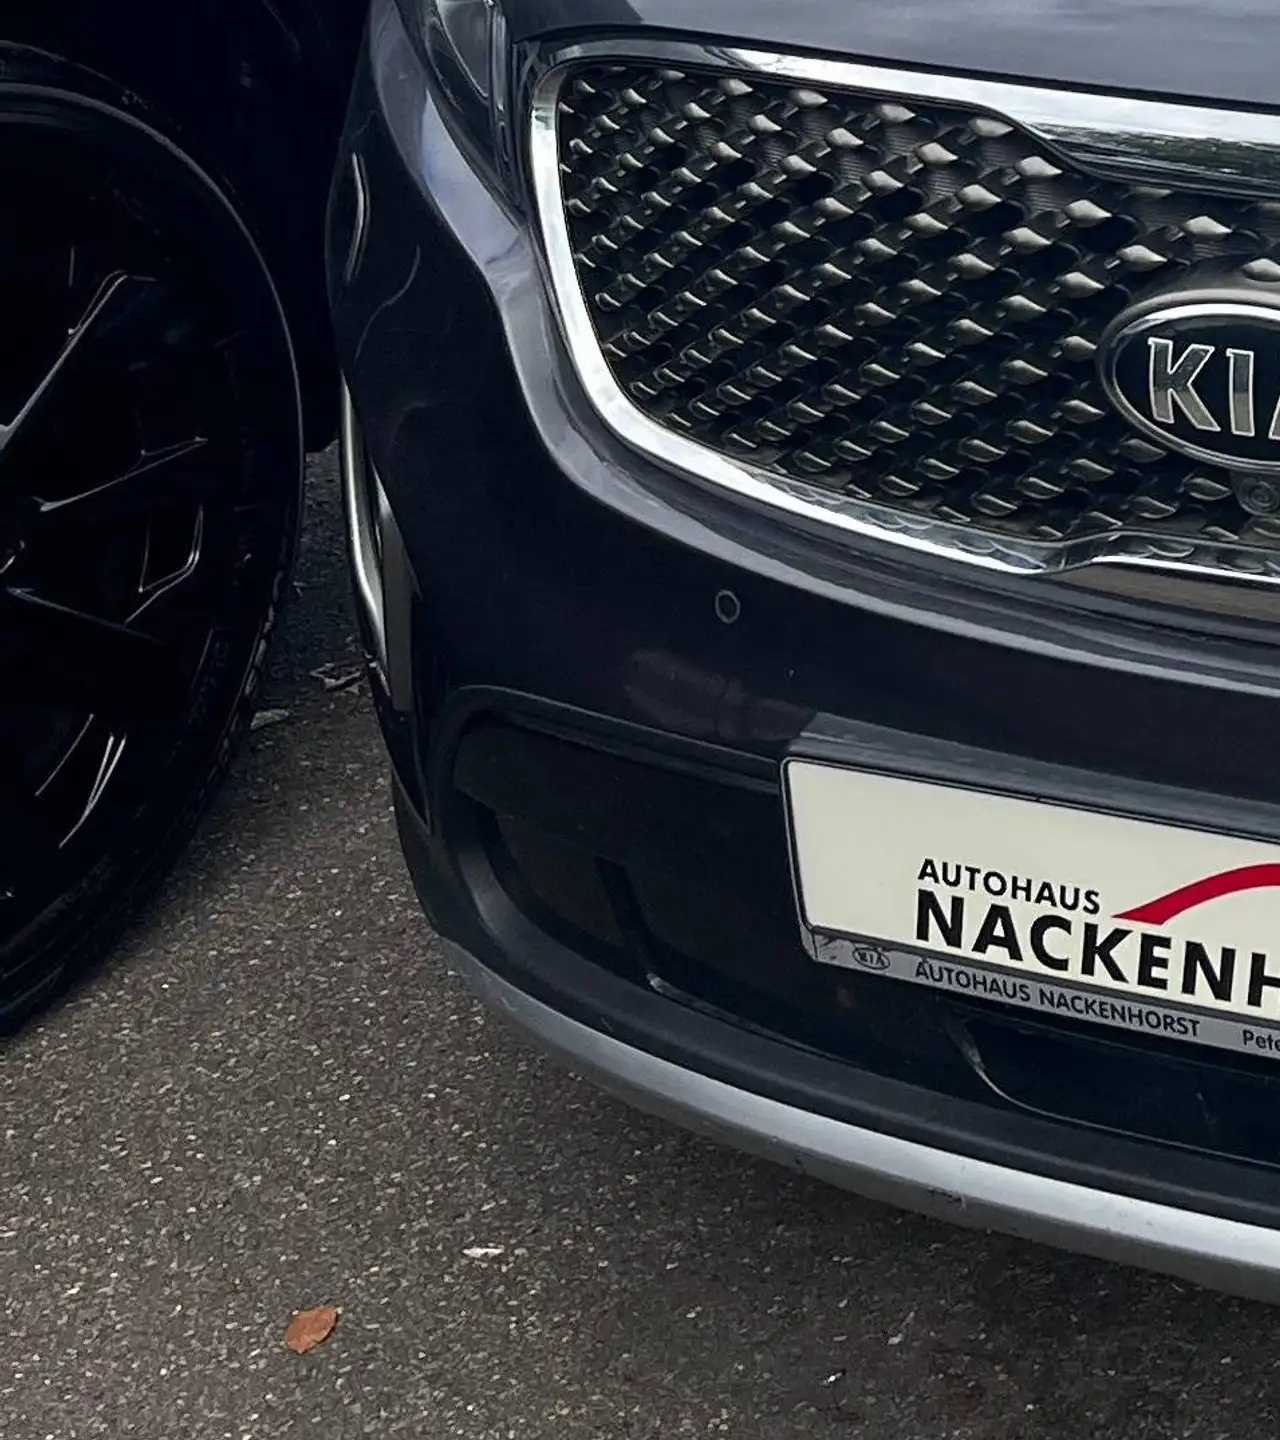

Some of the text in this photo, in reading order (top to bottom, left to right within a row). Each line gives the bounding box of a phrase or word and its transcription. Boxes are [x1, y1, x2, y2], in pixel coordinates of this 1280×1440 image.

[917, 858, 1101, 916] AUTOHAUS
[915, 960, 1031, 1003] AUTOHAUS
[1038, 988, 1201, 1039] NACKENHORST
